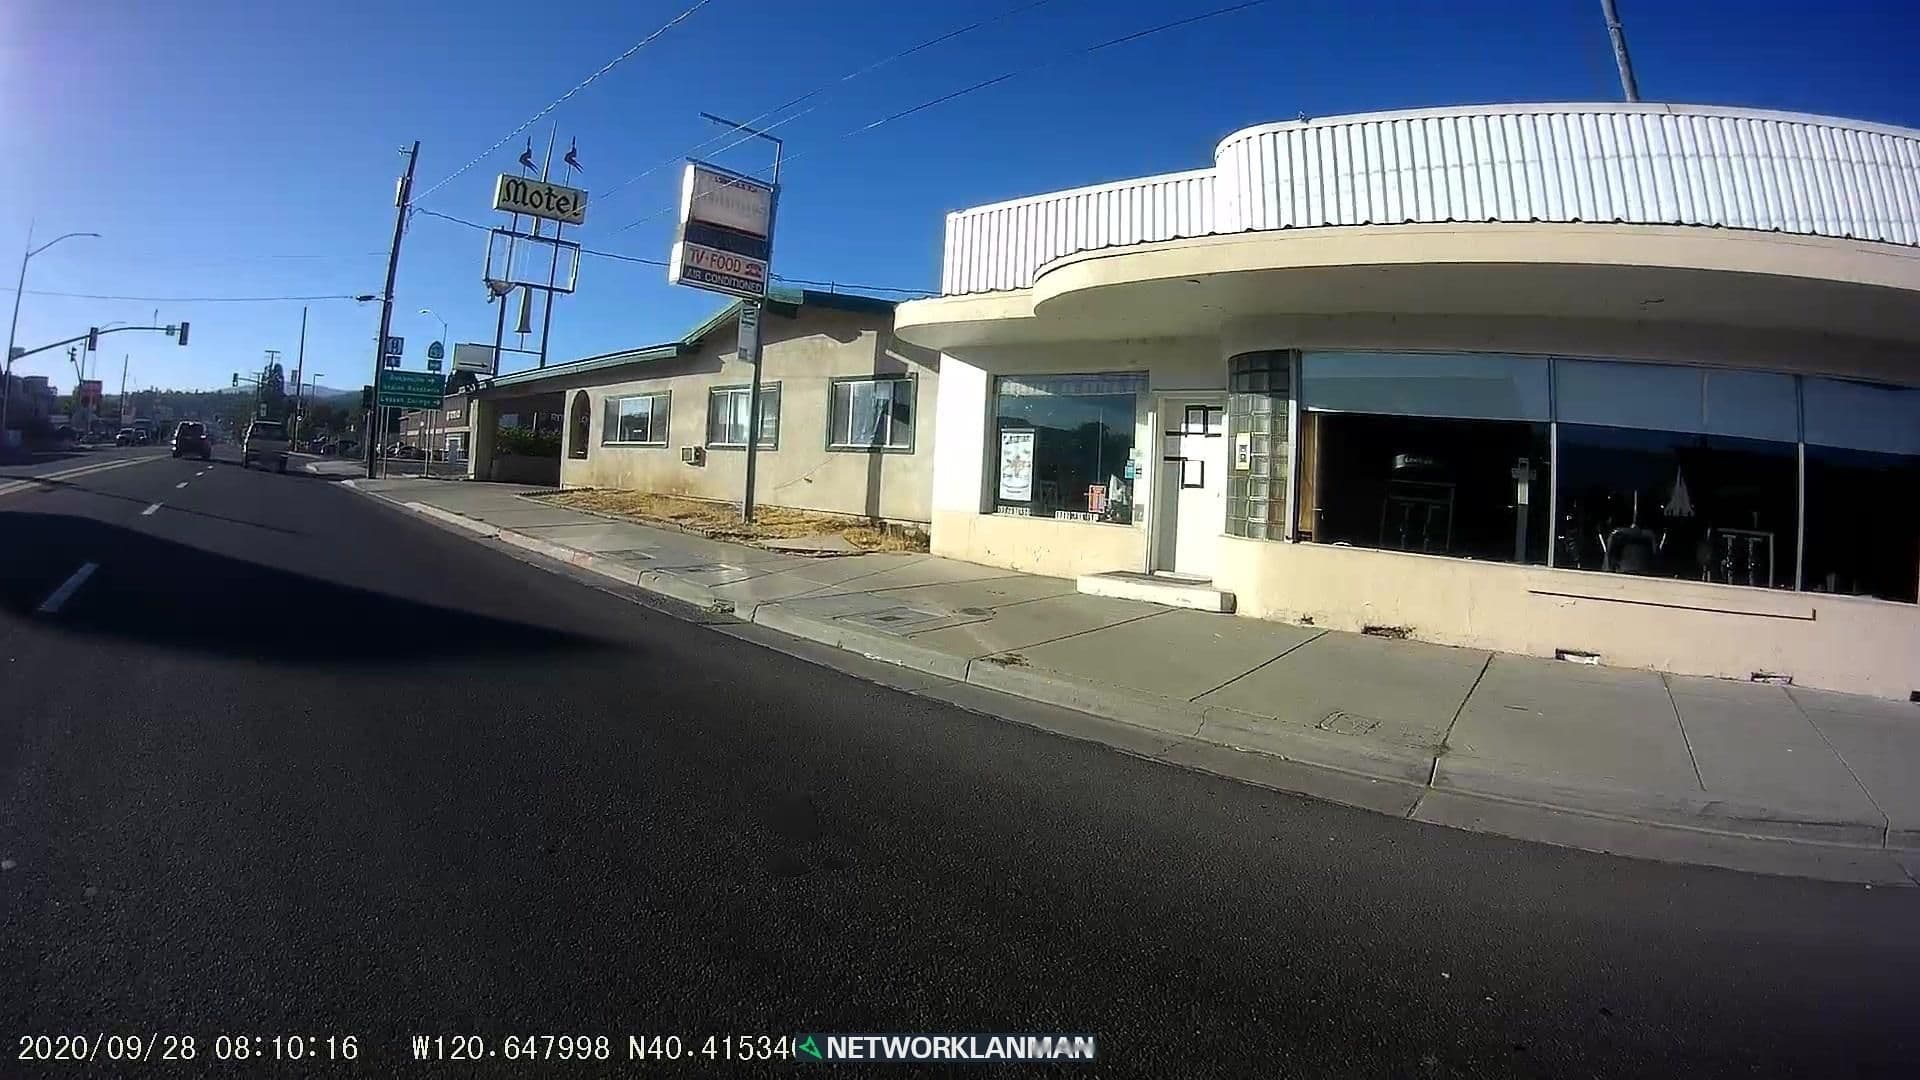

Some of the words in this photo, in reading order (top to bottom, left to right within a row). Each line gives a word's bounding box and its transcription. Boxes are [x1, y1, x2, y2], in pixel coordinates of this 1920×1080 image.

[502, 179, 581, 216] Motel
[710, 253, 741, 272] FOOD
[686, 268, 701, 281] AIR
[704, 272, 763, 293] CONDITIONED
